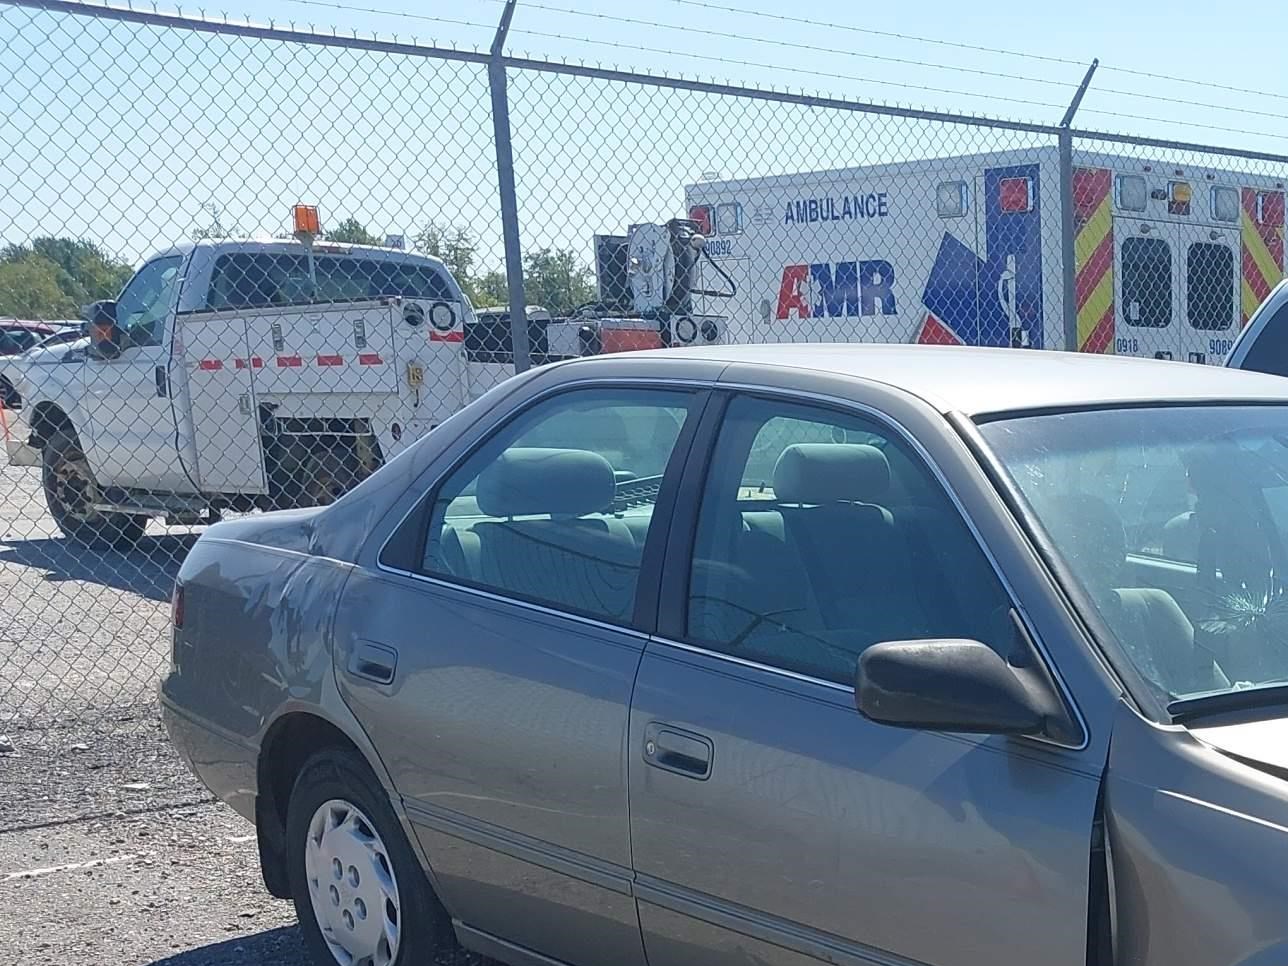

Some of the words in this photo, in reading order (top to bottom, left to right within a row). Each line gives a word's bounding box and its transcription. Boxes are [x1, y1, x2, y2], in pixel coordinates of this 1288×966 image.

[785, 192, 888, 224] AMBULANCE
[776, 260, 898, 320] AMR
[1116, 338, 1138, 352] 0918
